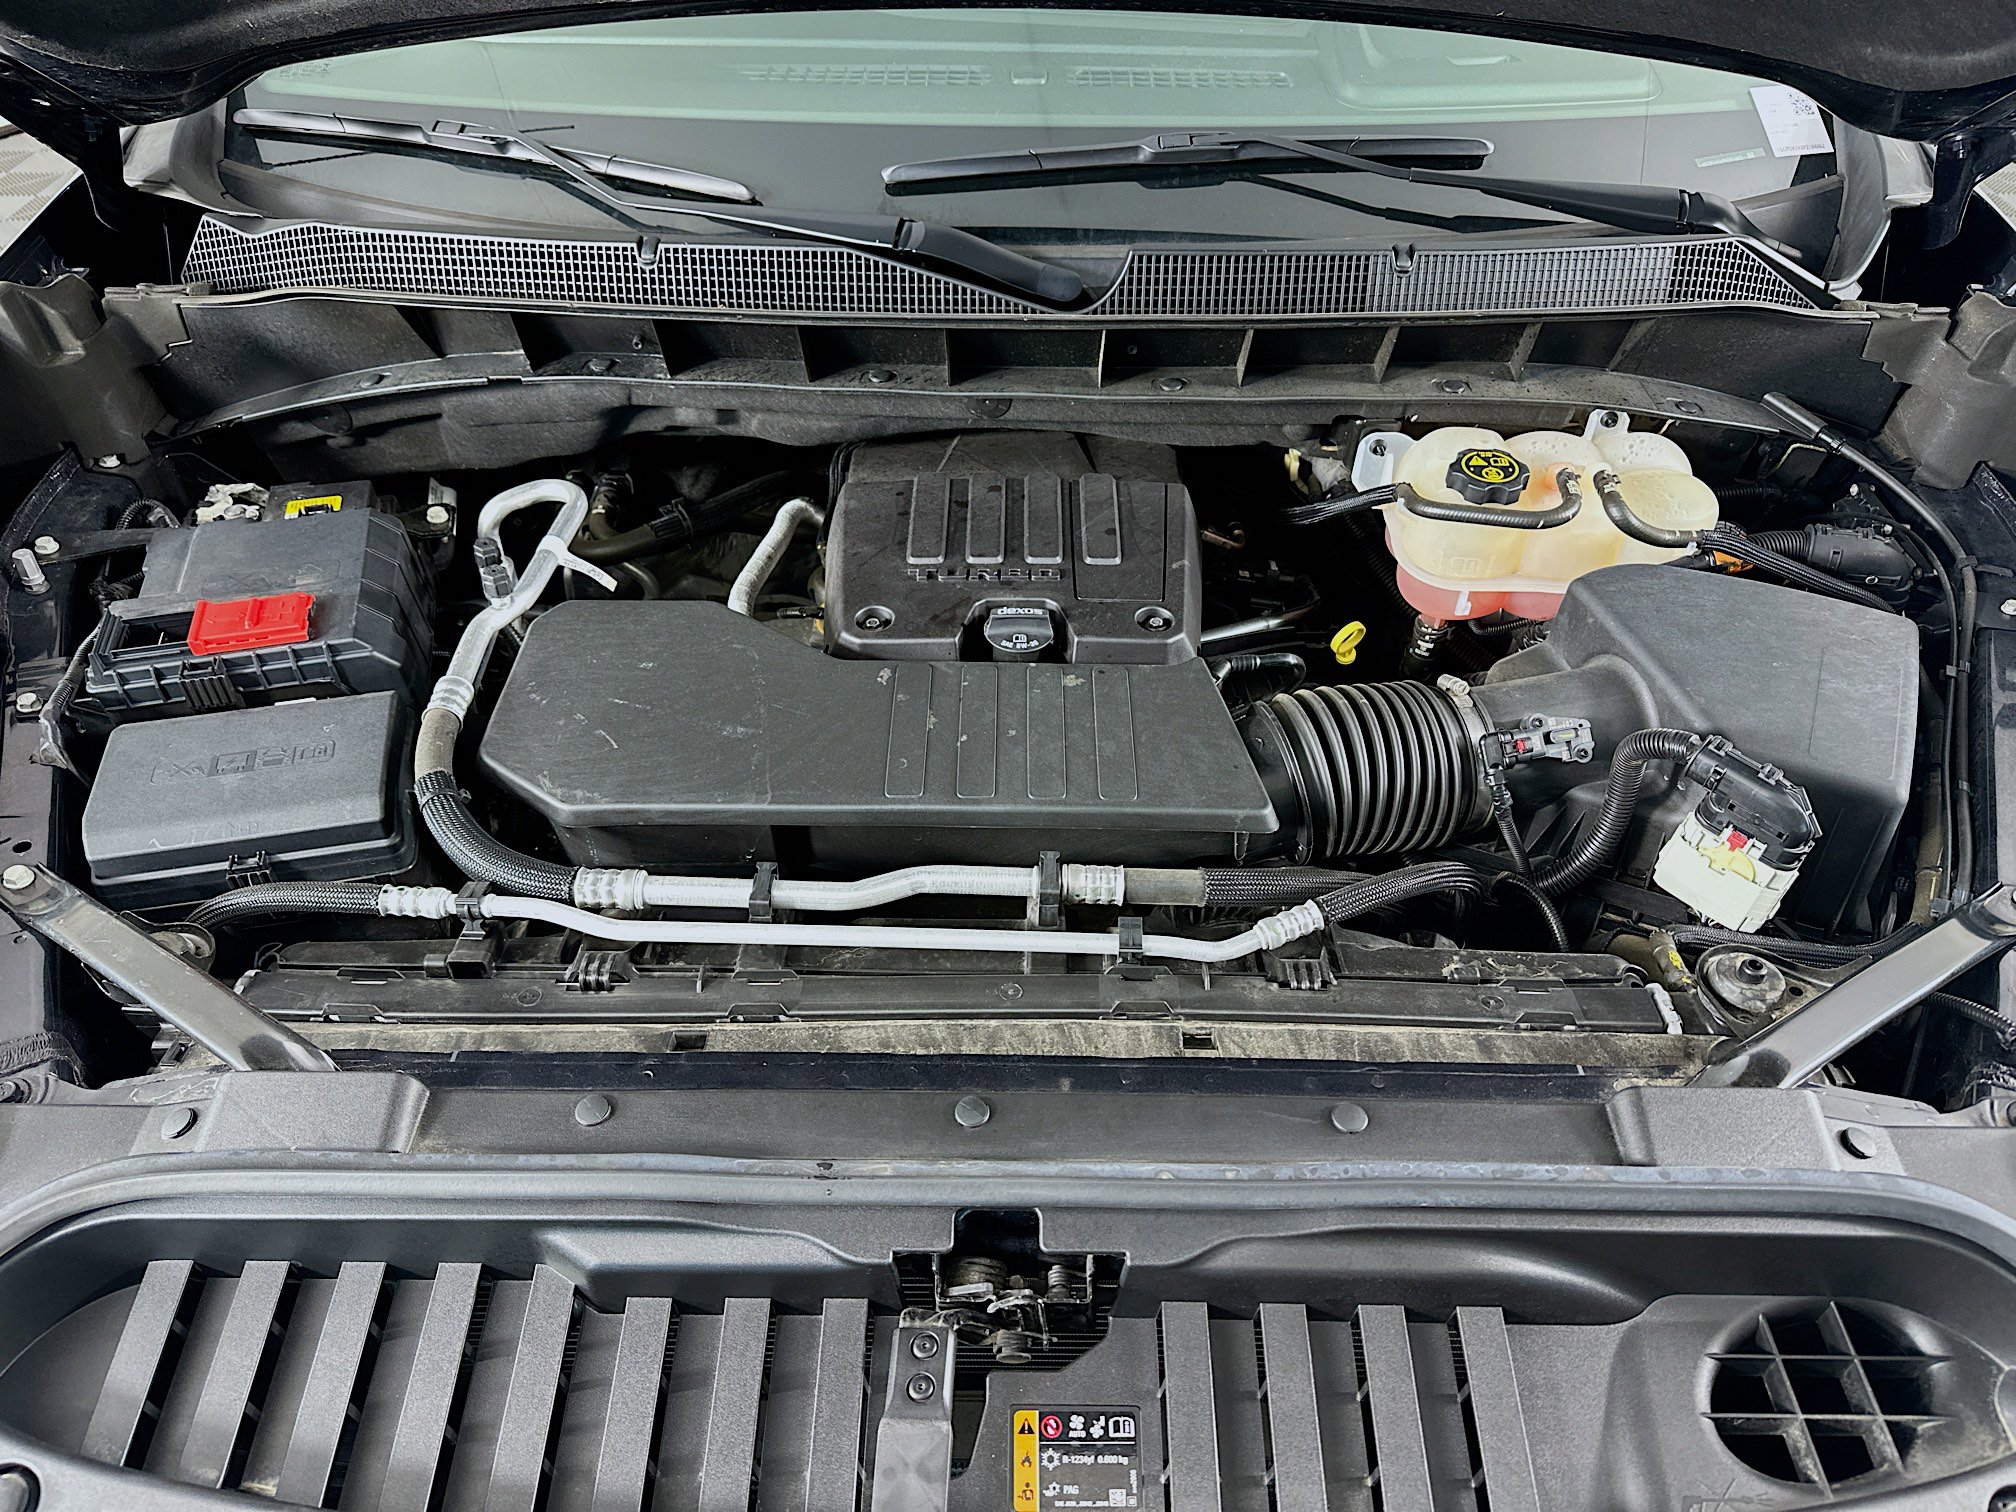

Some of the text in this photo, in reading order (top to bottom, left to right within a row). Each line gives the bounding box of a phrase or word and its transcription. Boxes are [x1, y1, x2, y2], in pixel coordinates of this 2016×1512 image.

[907, 568, 1060, 581] TURBO
[997, 607, 1043, 615] dexos
[1001, 640, 1014, 648] SAE
[1118, 1455, 1129, 1465] kg
[1063, 1485, 1080, 1494] PAG
